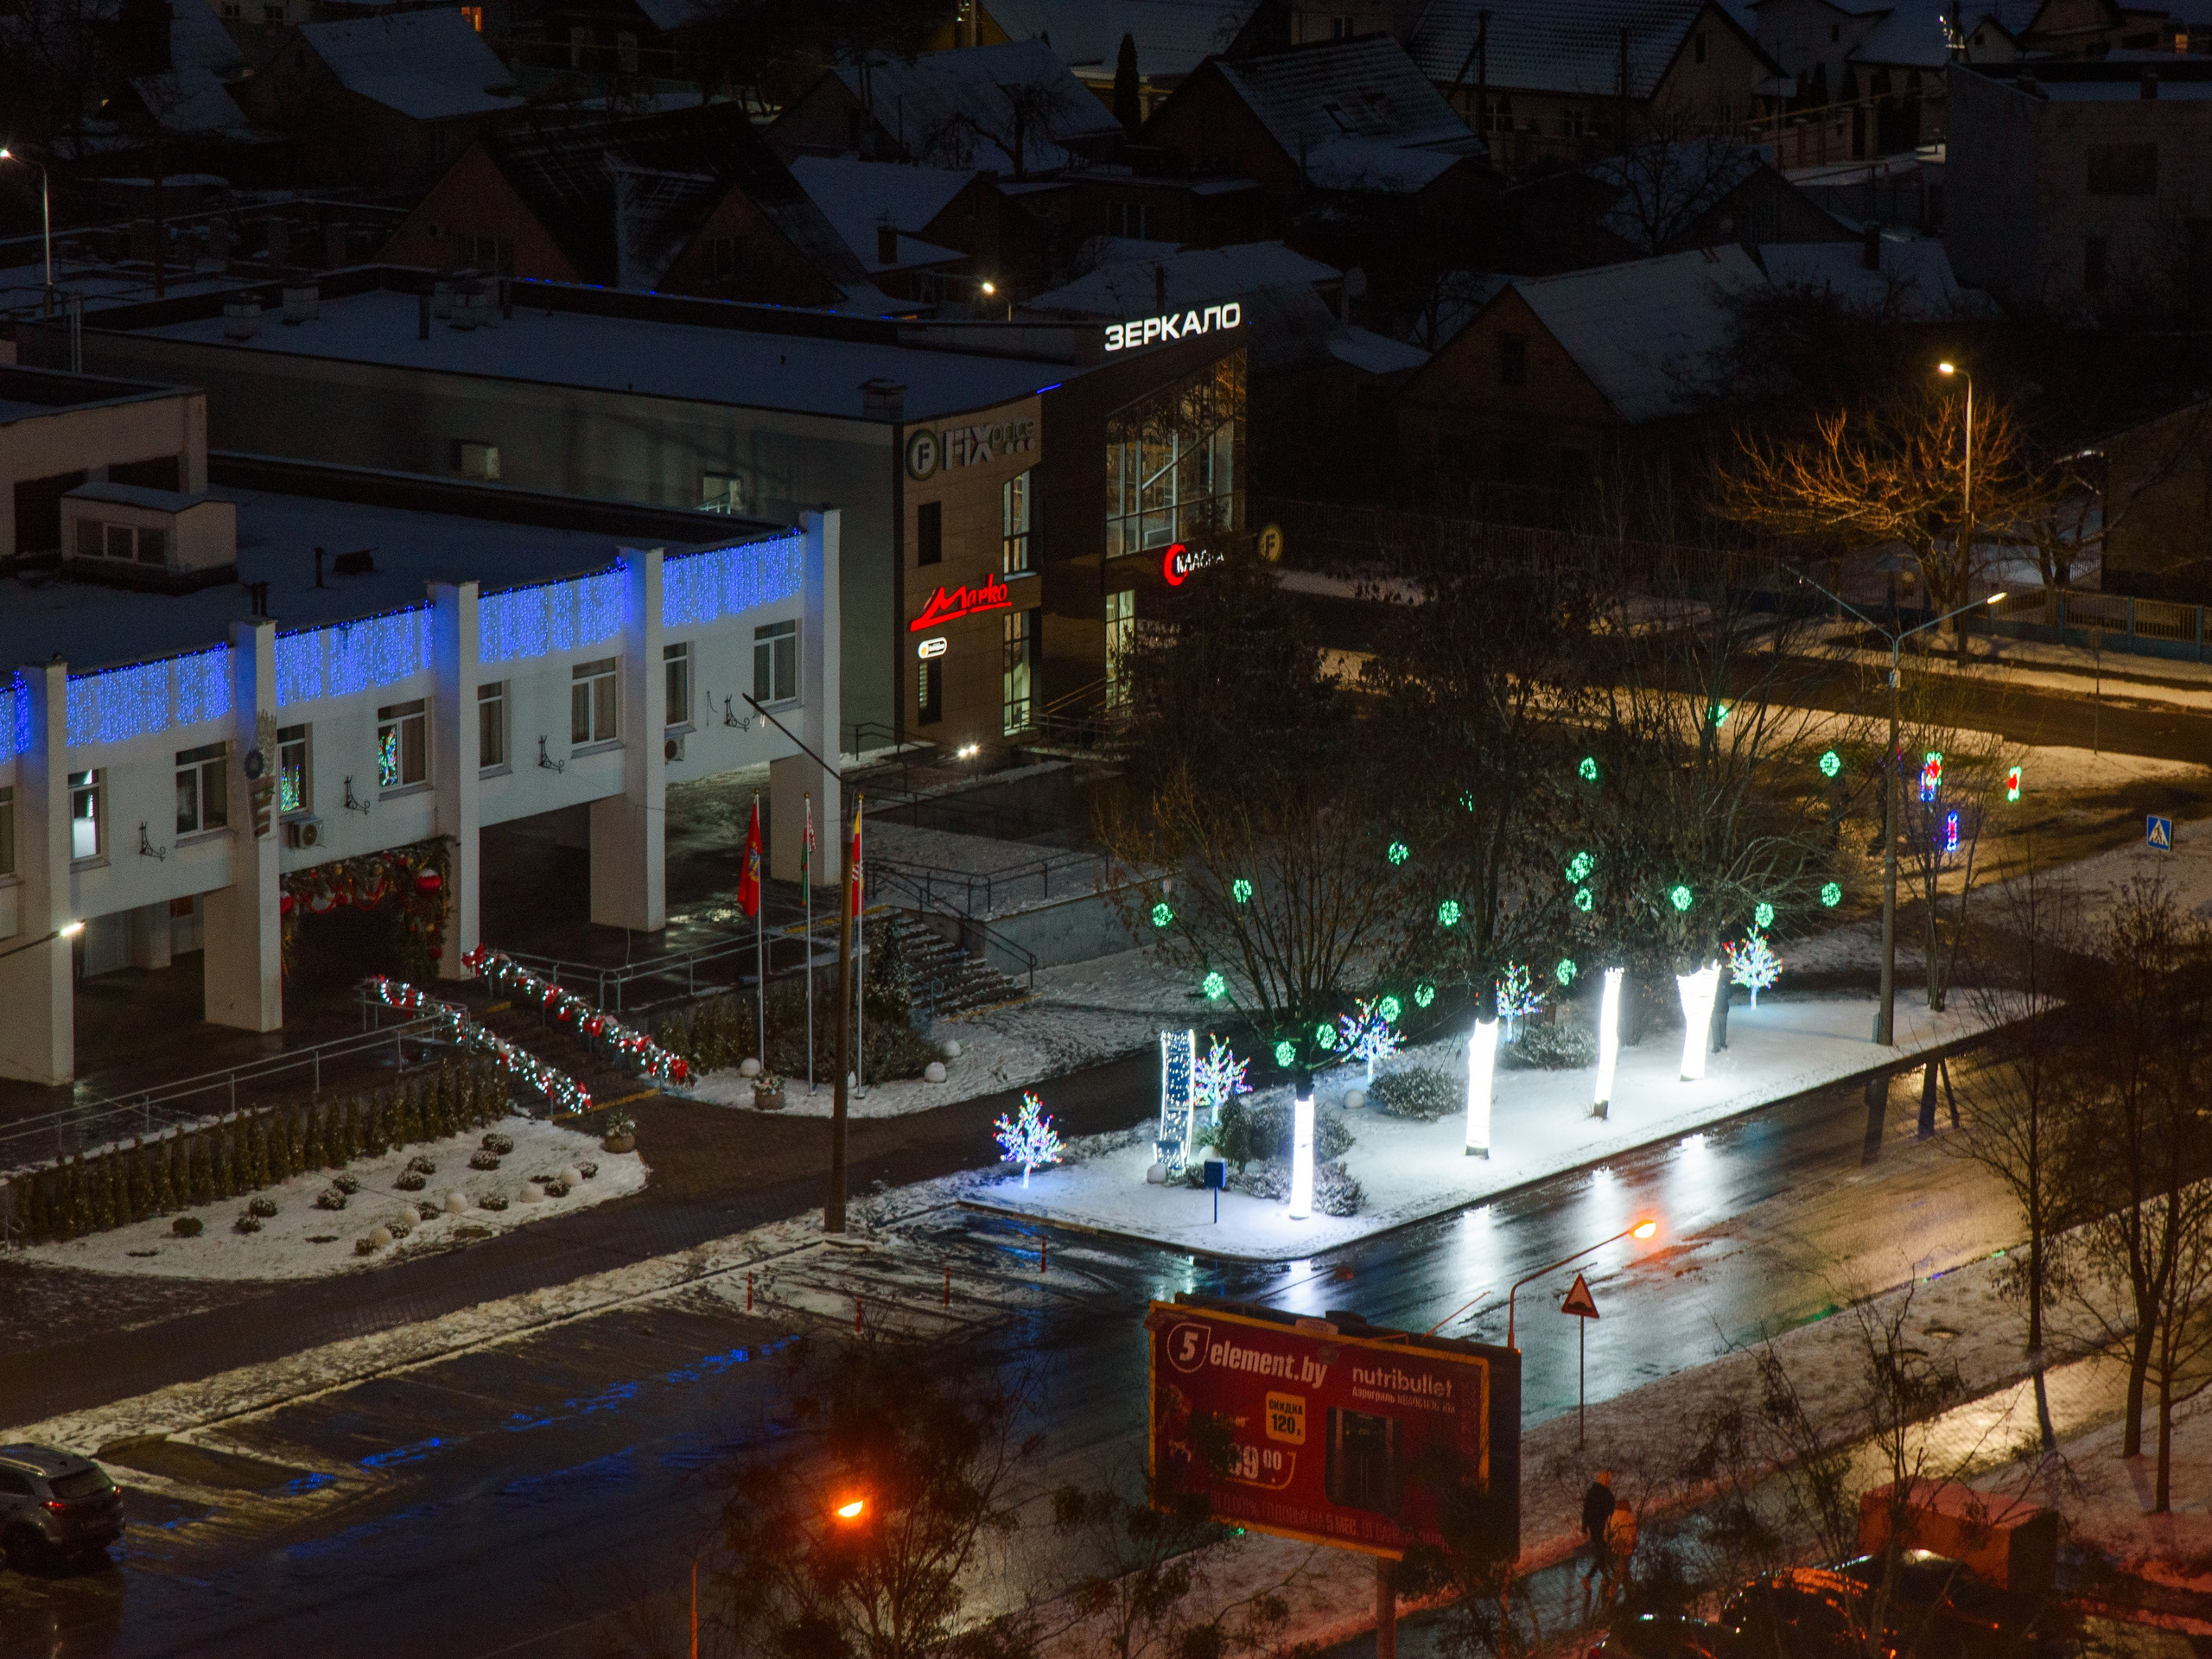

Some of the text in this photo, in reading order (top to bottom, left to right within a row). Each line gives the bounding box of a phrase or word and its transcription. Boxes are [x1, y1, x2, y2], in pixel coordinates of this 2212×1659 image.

[1104, 302, 1241, 352] ЗЕРКАЛО
[1179, 1331, 1328, 1389] 5 element.by
[1352, 1367, 1452, 1397] nutribullet
[1268, 1400, 1303, 1415] СКИДКА
[1271, 1414, 1295, 1434] 120
[1262, 1448, 1282, 1471] 00
